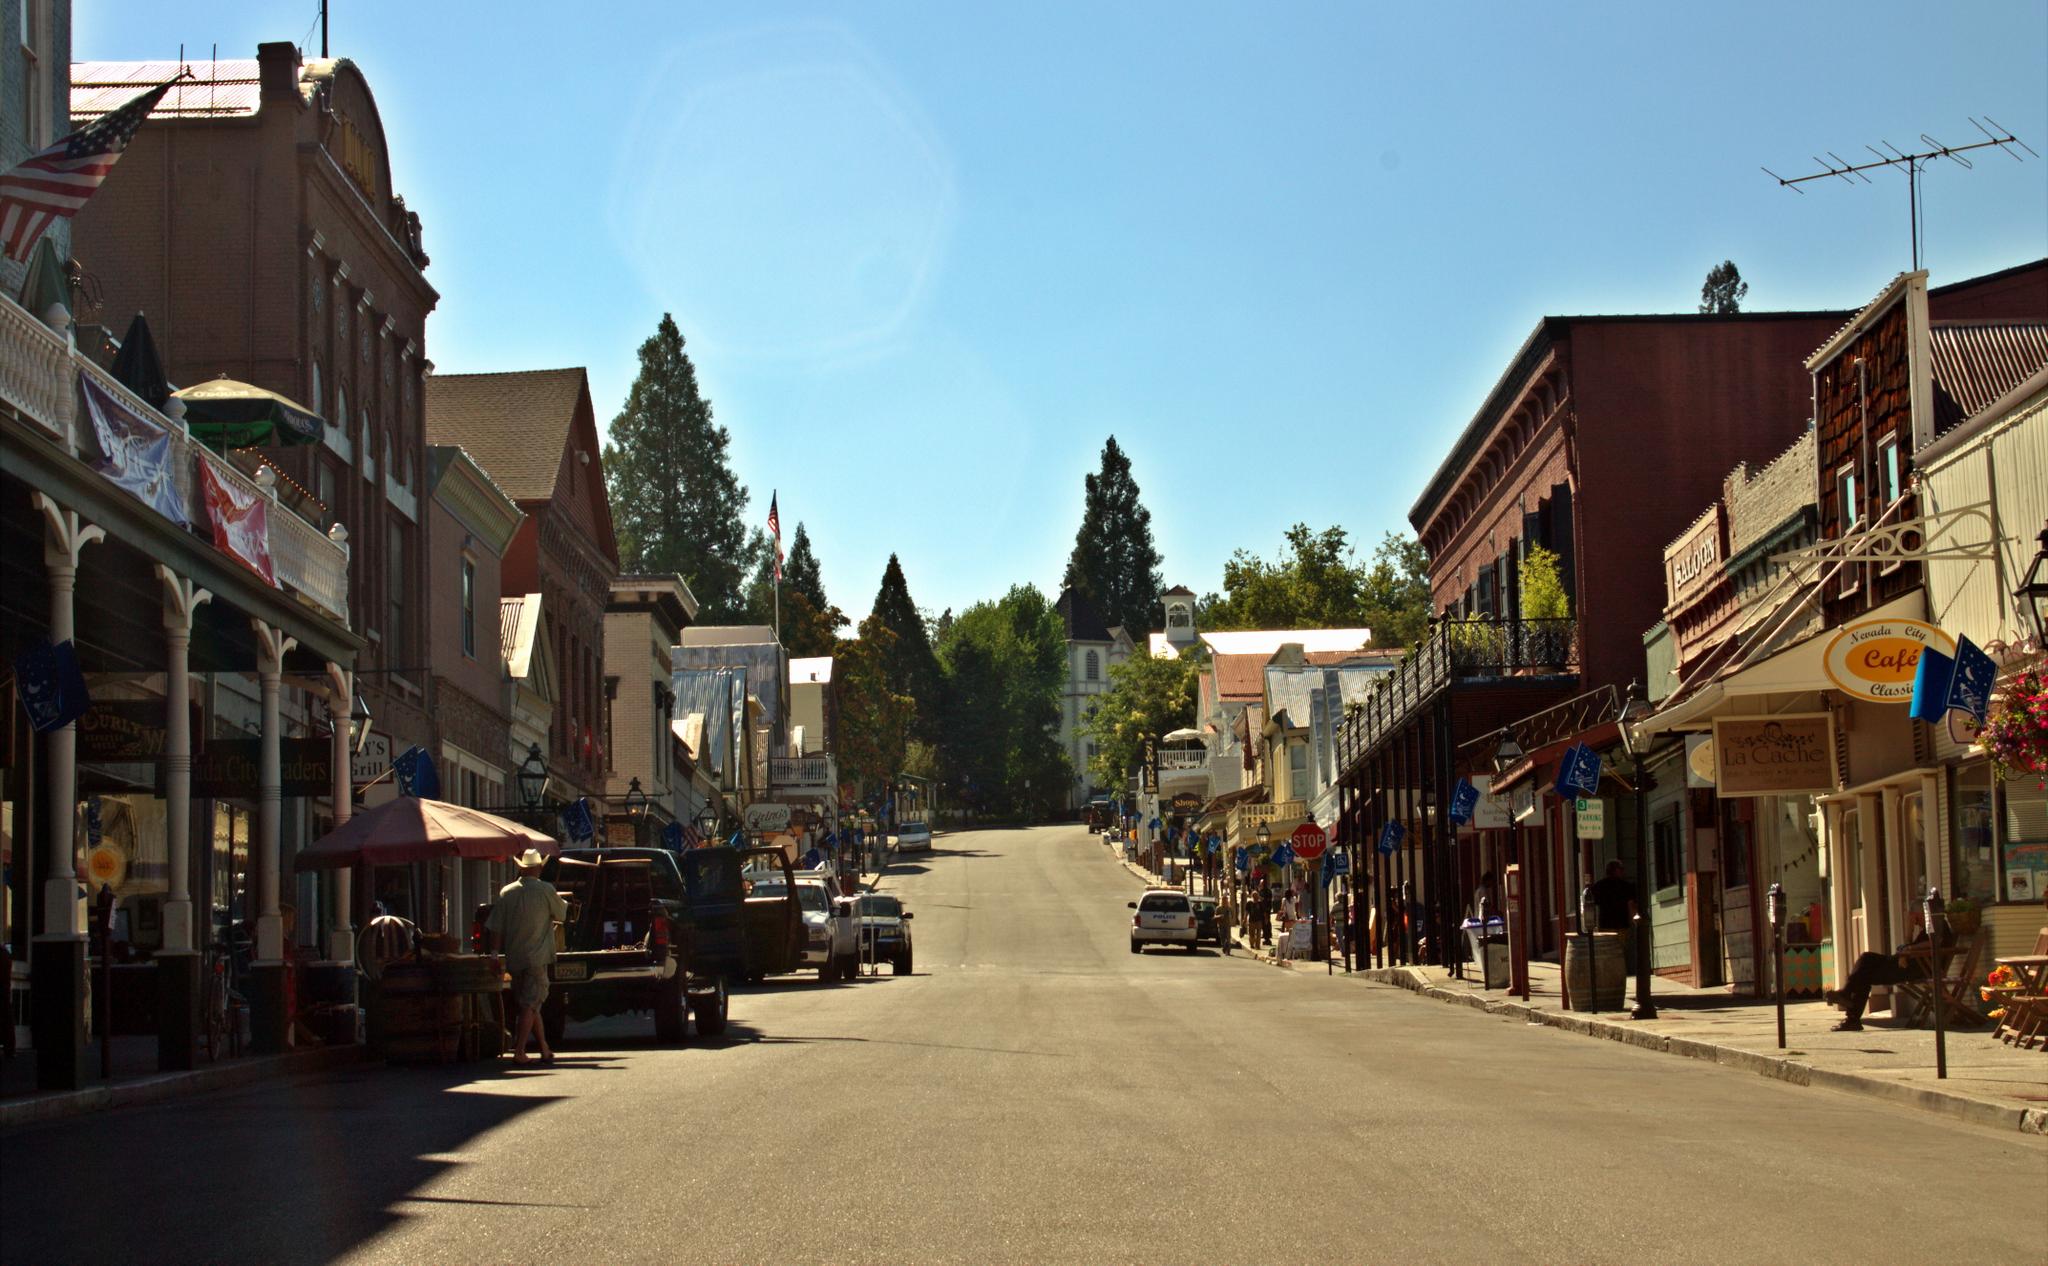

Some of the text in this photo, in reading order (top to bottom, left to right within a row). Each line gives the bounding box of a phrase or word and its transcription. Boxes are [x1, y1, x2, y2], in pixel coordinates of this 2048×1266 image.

[1674, 534, 1716, 590] SALOON
[1851, 625, 1928, 645] Nevada City
[1863, 648, 1919, 673] Café
[1723, 743, 1825, 766] La Cache
[1174, 799, 1201, 809] Shops
[1578, 800, 1586, 810] 3
[1578, 814, 1602, 822] PARKING
[1293, 833, 1325, 848] STOP
